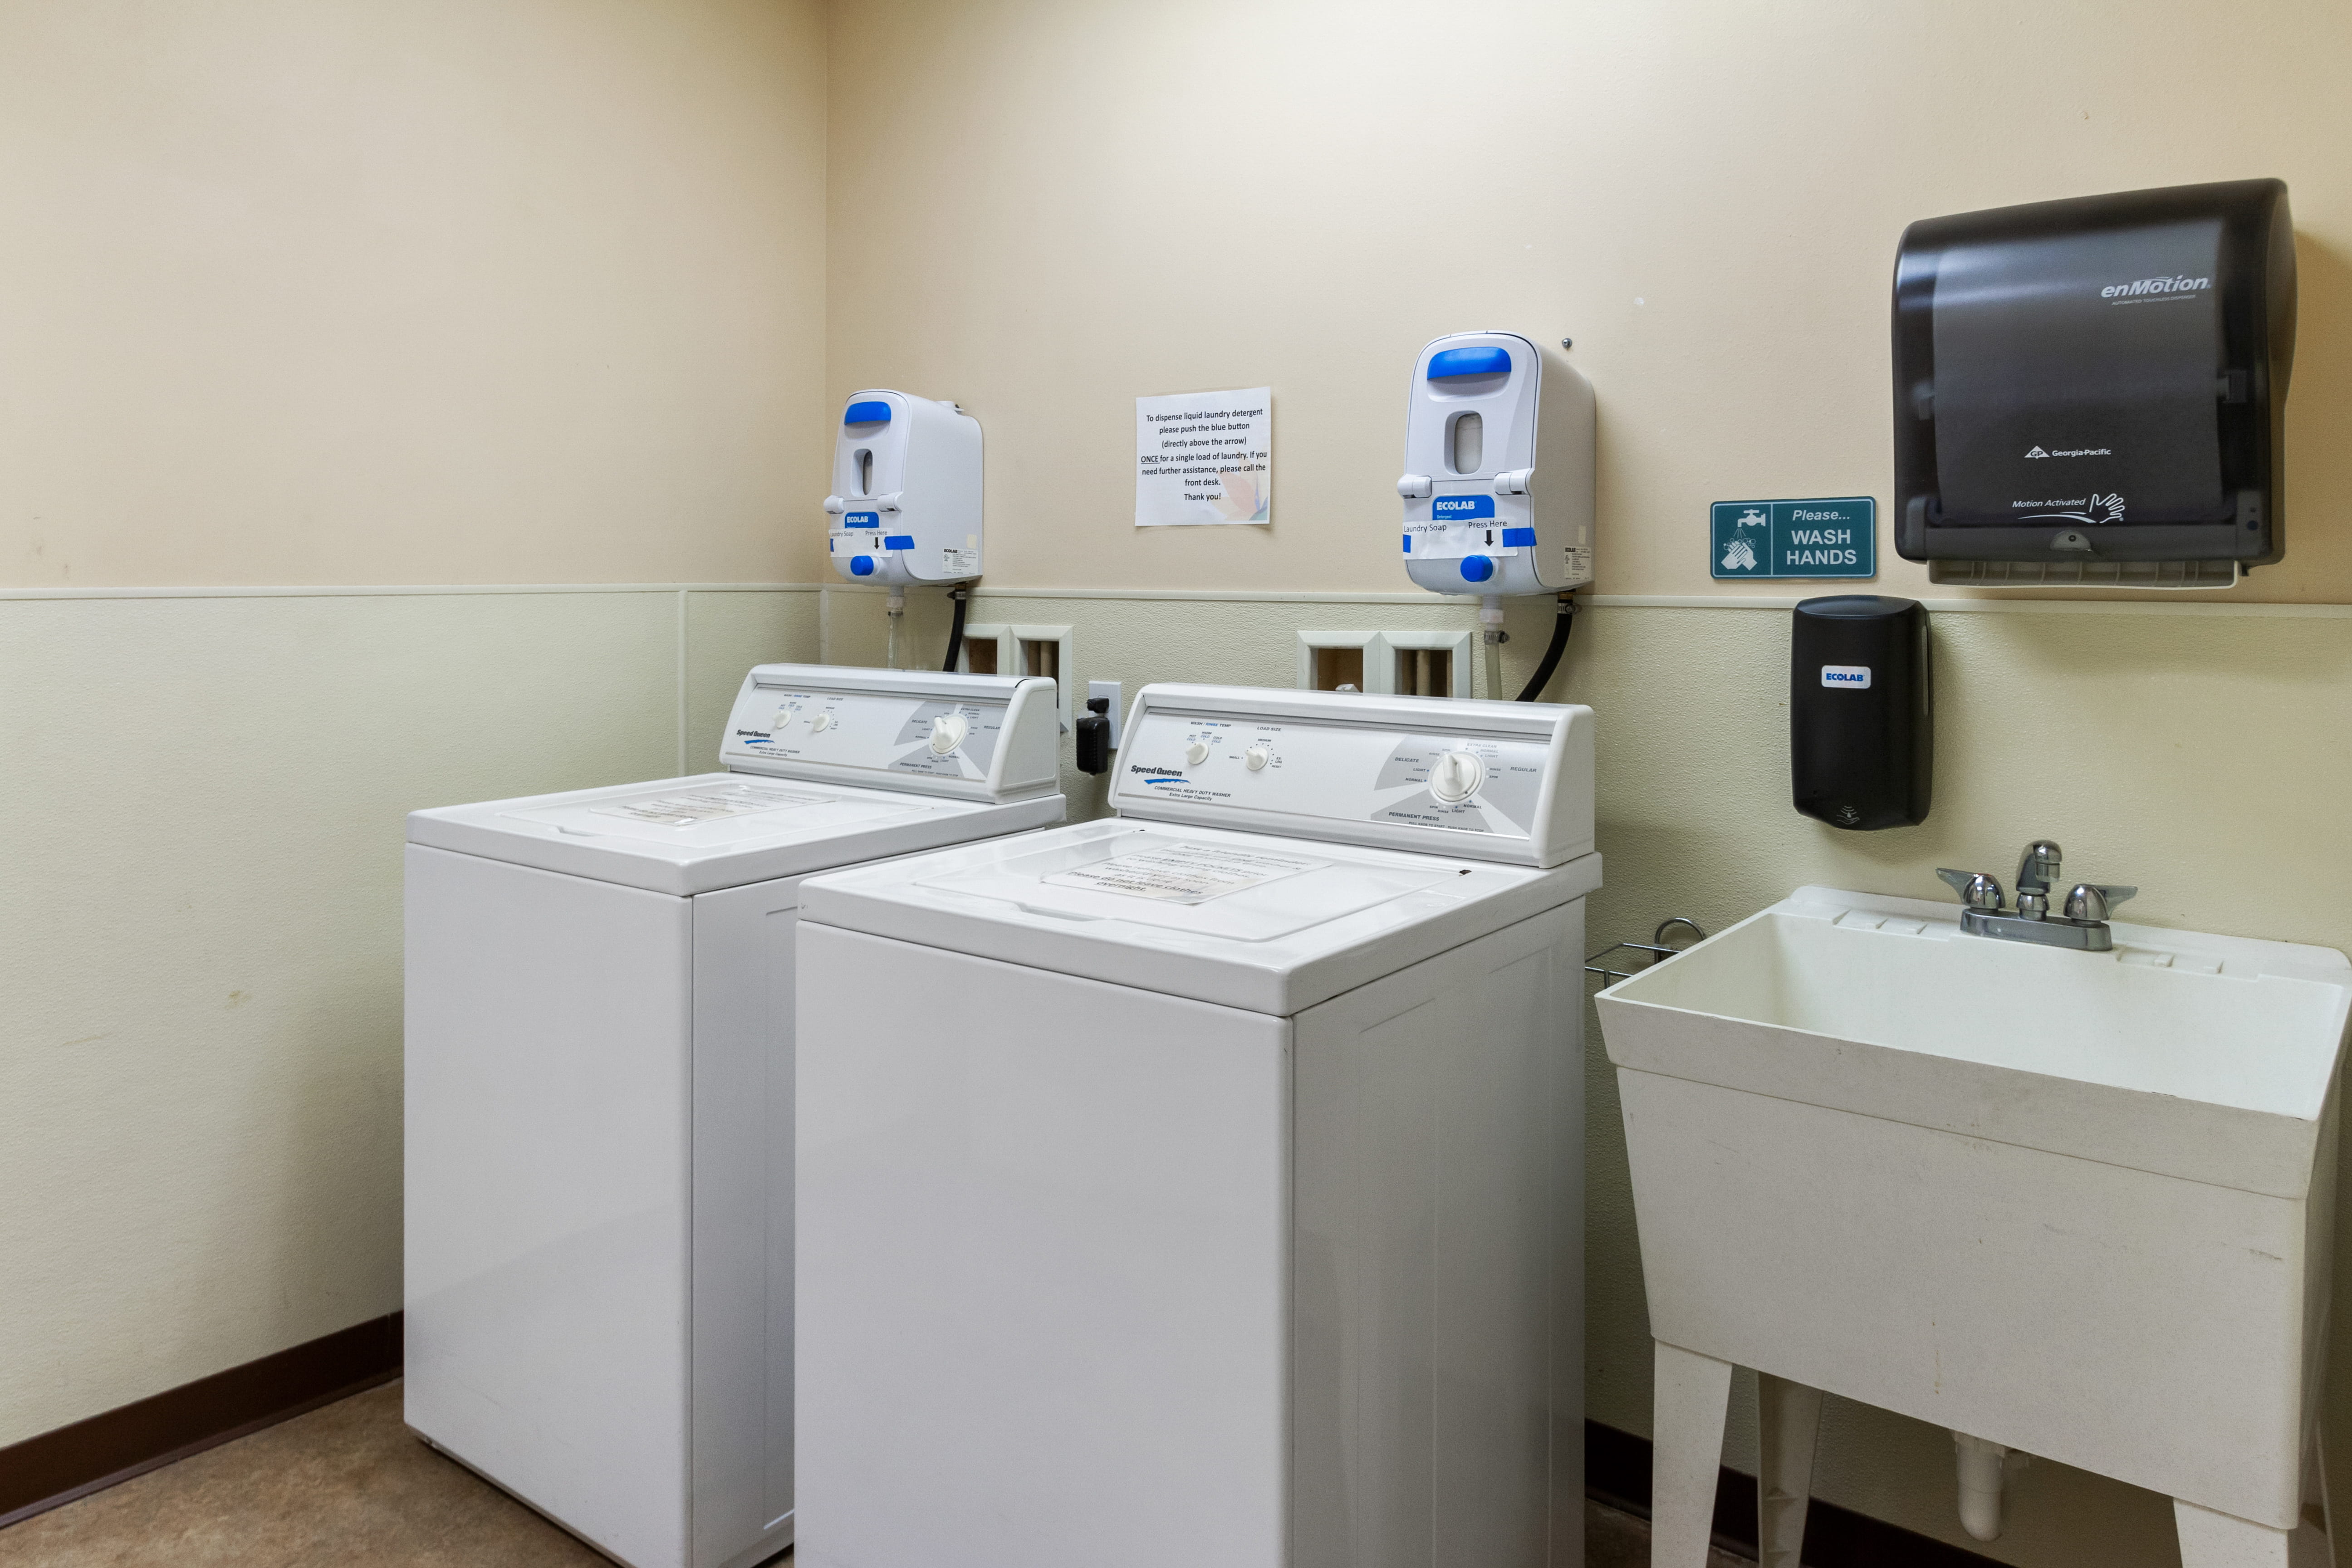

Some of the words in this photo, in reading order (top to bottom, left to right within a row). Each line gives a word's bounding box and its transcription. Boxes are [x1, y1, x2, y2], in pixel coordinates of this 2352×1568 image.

[2101, 275, 2209, 298] enMotion
[1155, 414, 1182, 422] dispense
[1184, 411, 1202, 421] liquid
[1204, 410, 1230, 419] laundry
[1232, 408, 1263, 417] detergent
[1159, 426, 1179, 435] please
[1181, 425, 1196, 434] push
[1162, 439, 1188, 449] (directly
[1225, 436, 1246, 445] arrow)
[1141, 455, 1158, 463] ONCE
[1176, 454, 1194, 462] single
[1221, 451, 1248, 460] laundry.
[1256, 451, 1267, 460] you
[2052, 448, 2111, 457] Georgia-Pacific
[1182, 466, 1218, 474] assistance,
[1220, 465, 1242, 474] please
[1206, 492, 1221, 501] you!
[1436, 500, 1475, 511] ECOLAB
[2044, 498, 2086, 507] Activated
[1792, 510, 1850, 521] Please...
[1404, 524, 1428, 534] Laundry
[1791, 529, 1851, 545] WASH
[1786, 549, 1857, 565] HANDS
[1826, 672, 1864, 681] ECOLAB
[753, 730, 771, 738] Queen
[1131, 765, 1156, 774] Speed
[1156, 767, 1182, 777] Queen
[1388, 811, 1421, 820] PERMANENT
